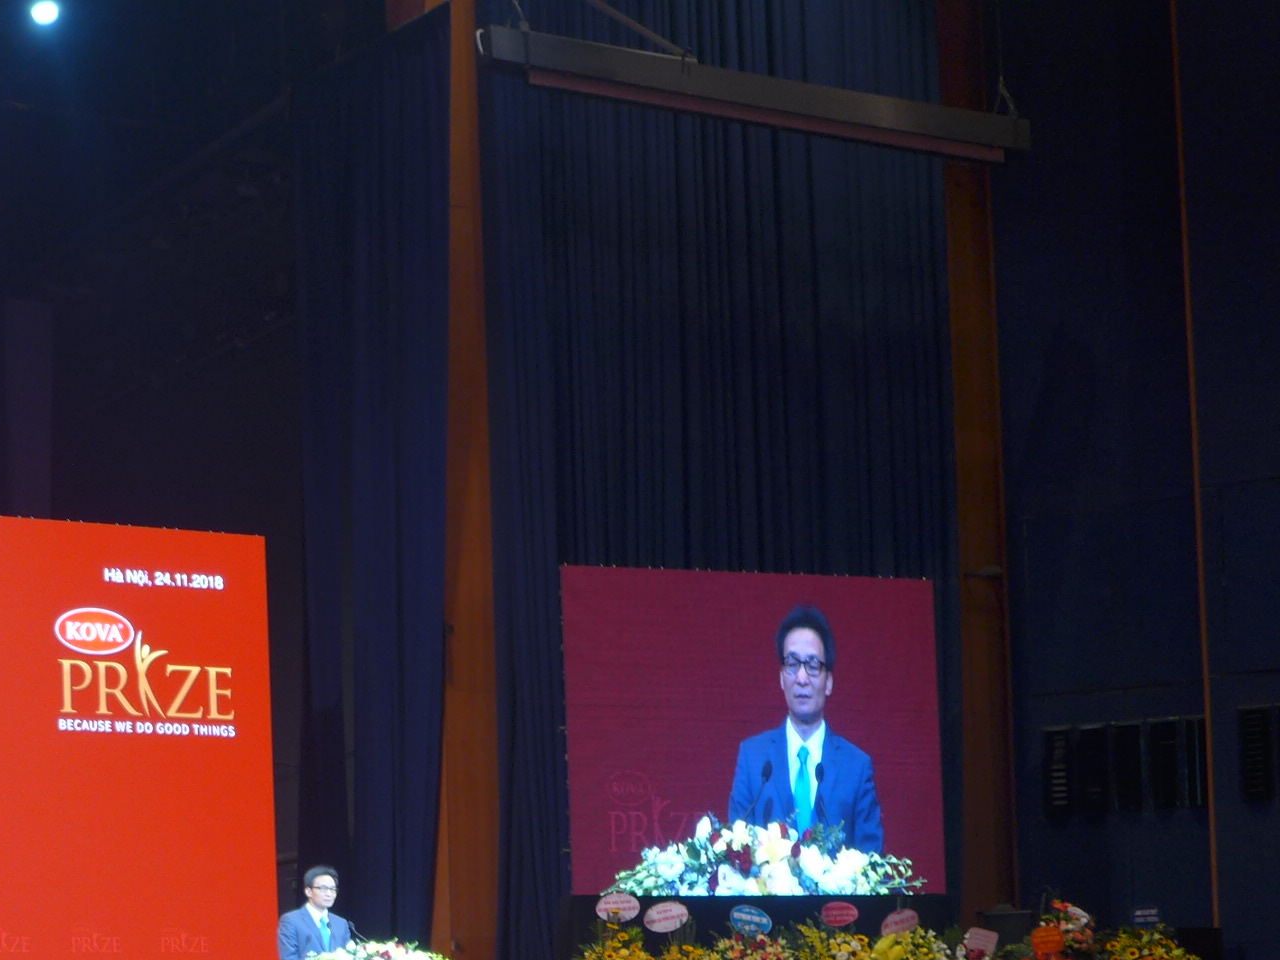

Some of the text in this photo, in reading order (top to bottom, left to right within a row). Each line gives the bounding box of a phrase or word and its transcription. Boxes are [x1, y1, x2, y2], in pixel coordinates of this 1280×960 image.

[104, 567, 124, 583] Hà
[154, 572, 224, 590] 24.11.2018
[65, 621, 124, 642] KOVA
[57, 631, 235, 719] PRIZE
[58, 718, 236, 737] BECAUSE WE DO GOOD THINGS
[608, 796, 707, 853] PRIZ
